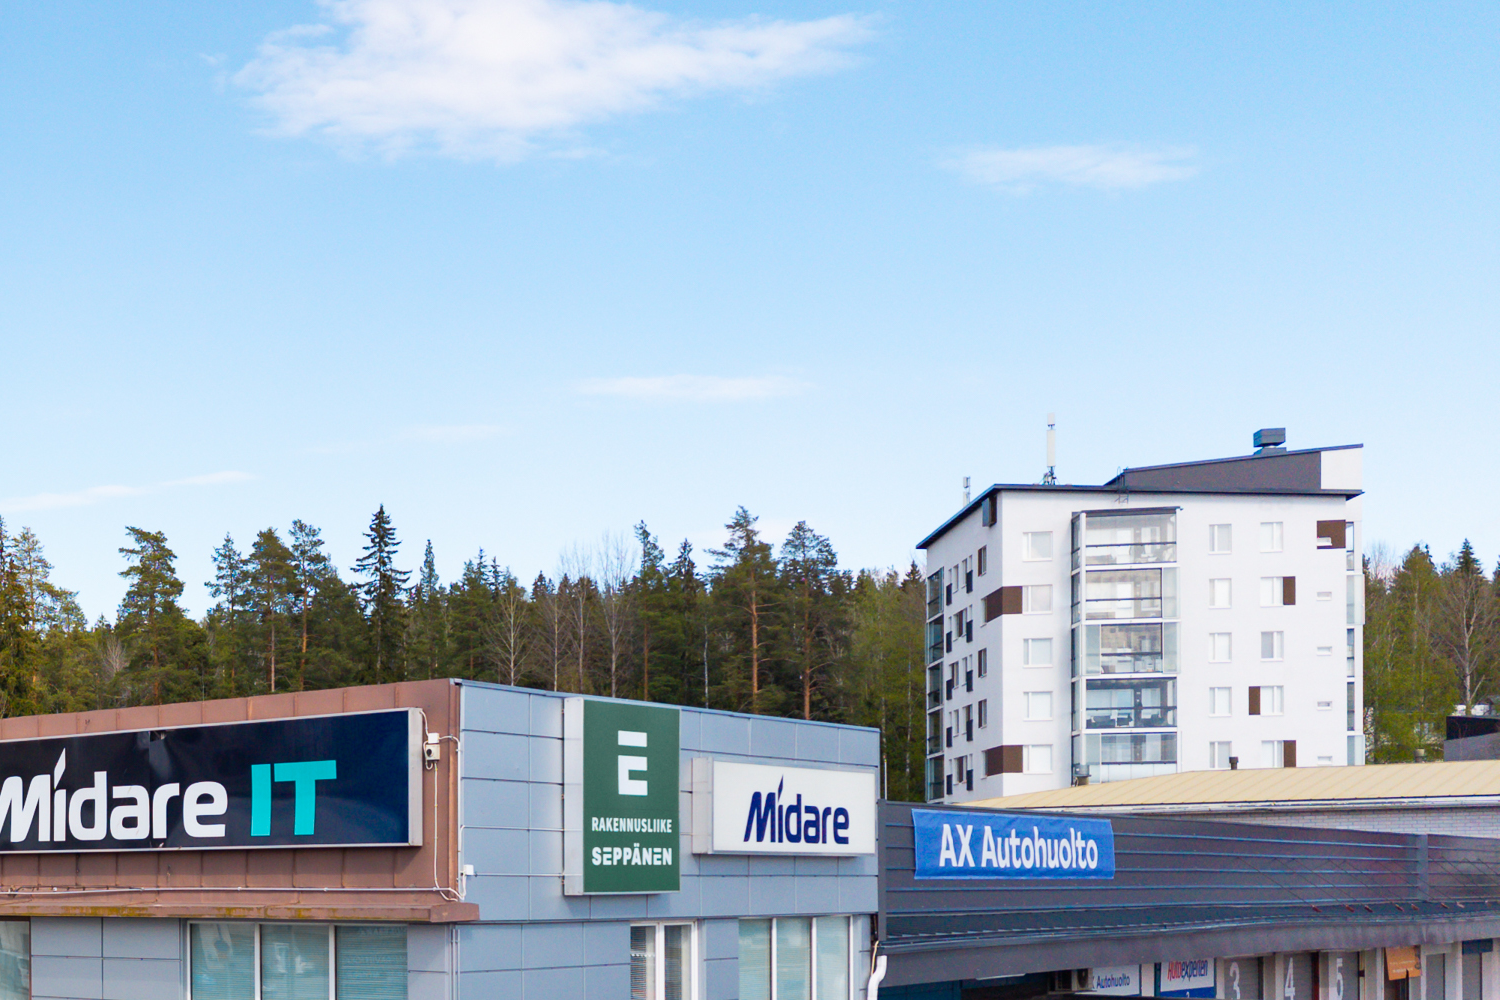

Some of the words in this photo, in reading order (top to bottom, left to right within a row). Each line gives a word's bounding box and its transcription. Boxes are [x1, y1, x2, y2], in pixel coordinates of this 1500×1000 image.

[250, 760, 337, 837] IT
[743, 774, 849, 845] Midare
[591, 815, 673, 834] RAKENNUSLIIKE
[591, 842, 673, 867] SEPPÄNEN
[939, 824, 975, 867] AX
[981, 827, 1098, 870] Autohuolto
[1096, 973, 1131, 990] Autohuolto
[1167, 959, 1209, 982] Autoexperten
[1229, 962, 1241, 999] 3
[1285, 957, 1296, 1000] 4
